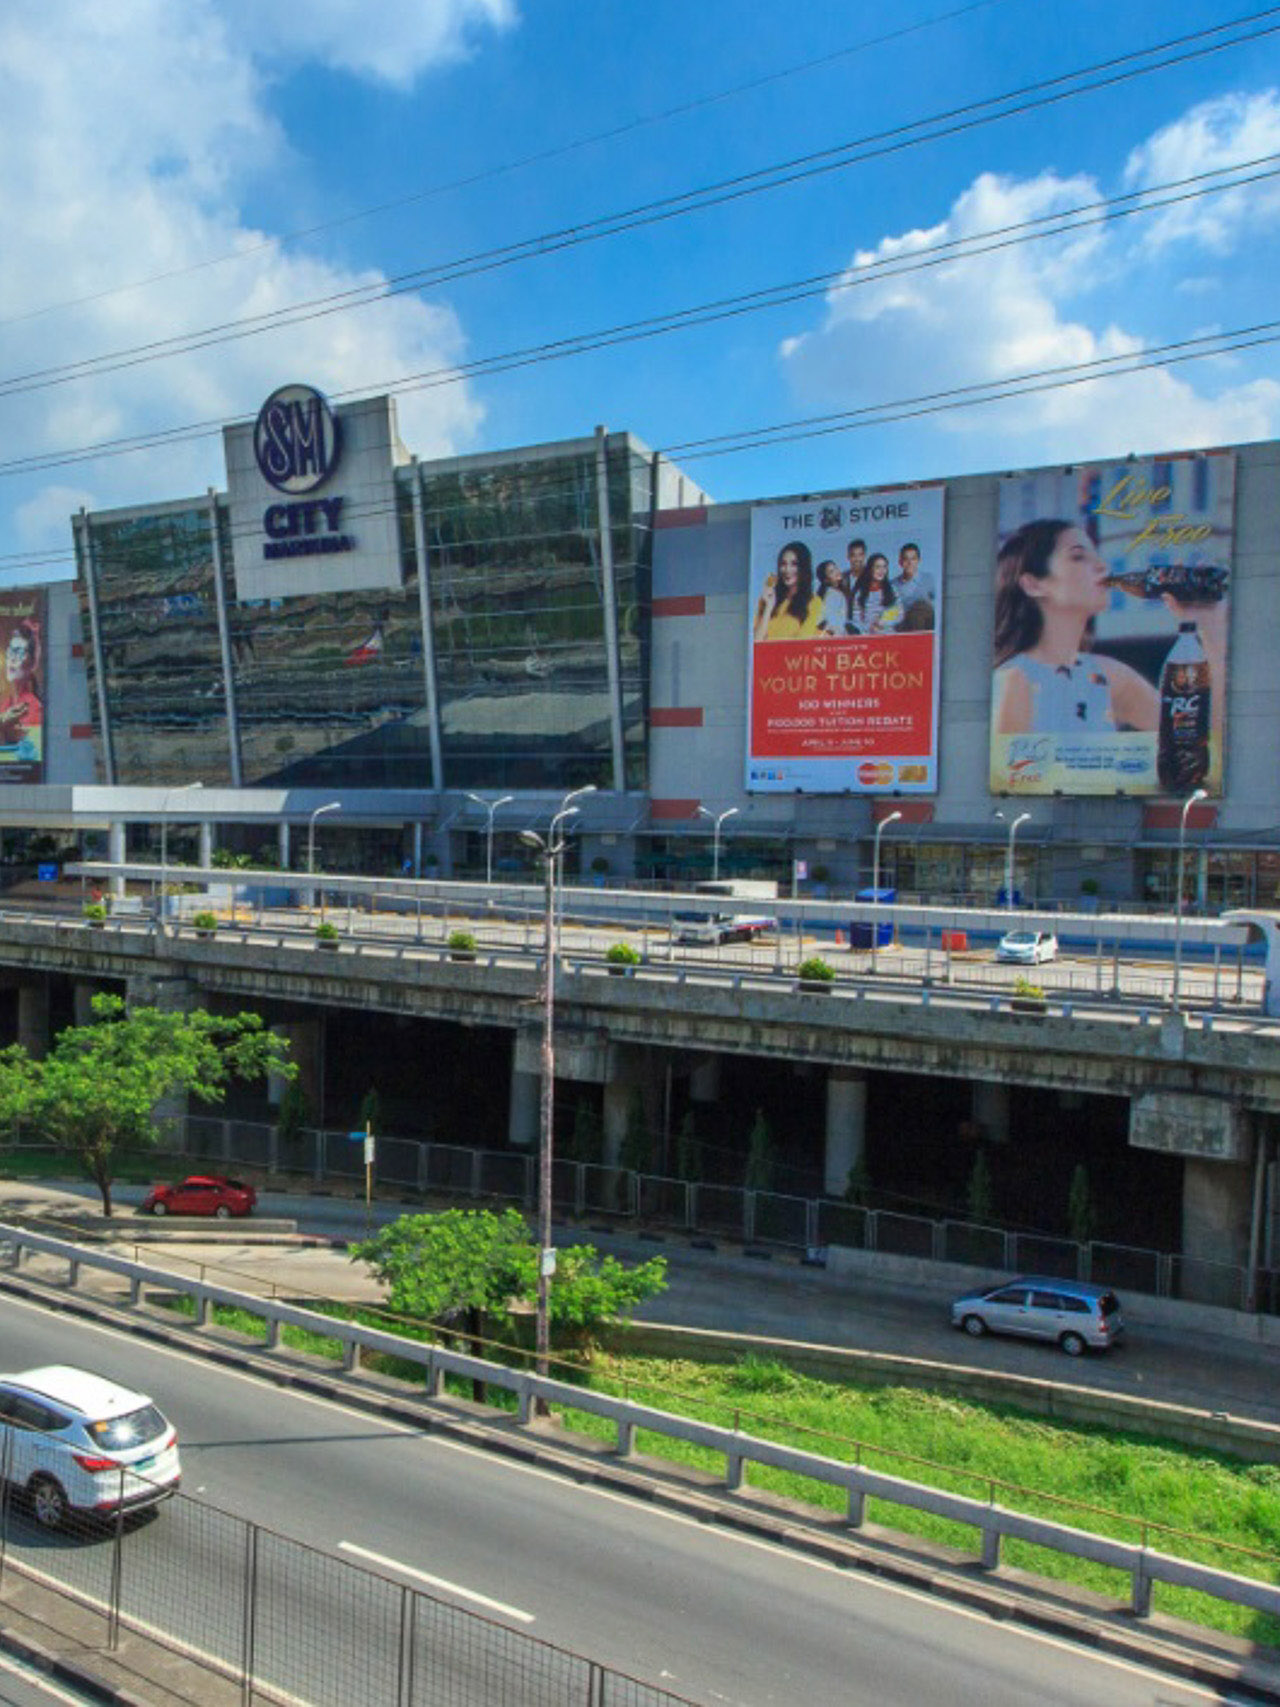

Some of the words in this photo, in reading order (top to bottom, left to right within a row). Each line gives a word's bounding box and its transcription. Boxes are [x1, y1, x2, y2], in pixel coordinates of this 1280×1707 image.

[262, 399, 326, 483] SM
[1091, 475, 1171, 519] Live
[264, 497, 344, 538] CITY
[782, 513, 815, 530] THE
[849, 502, 909, 524] STORE
[1125, 513, 1212, 551] Free
[785, 653, 827, 671] WIN
[836, 651, 900, 671] BACK
[760, 675, 817, 694] YOUR
[826, 672, 923, 692] TUITION
[823, 697, 880, 710] WINNERS
[819, 716, 864, 727] TUITION
[867, 715, 914, 727] REBATE
